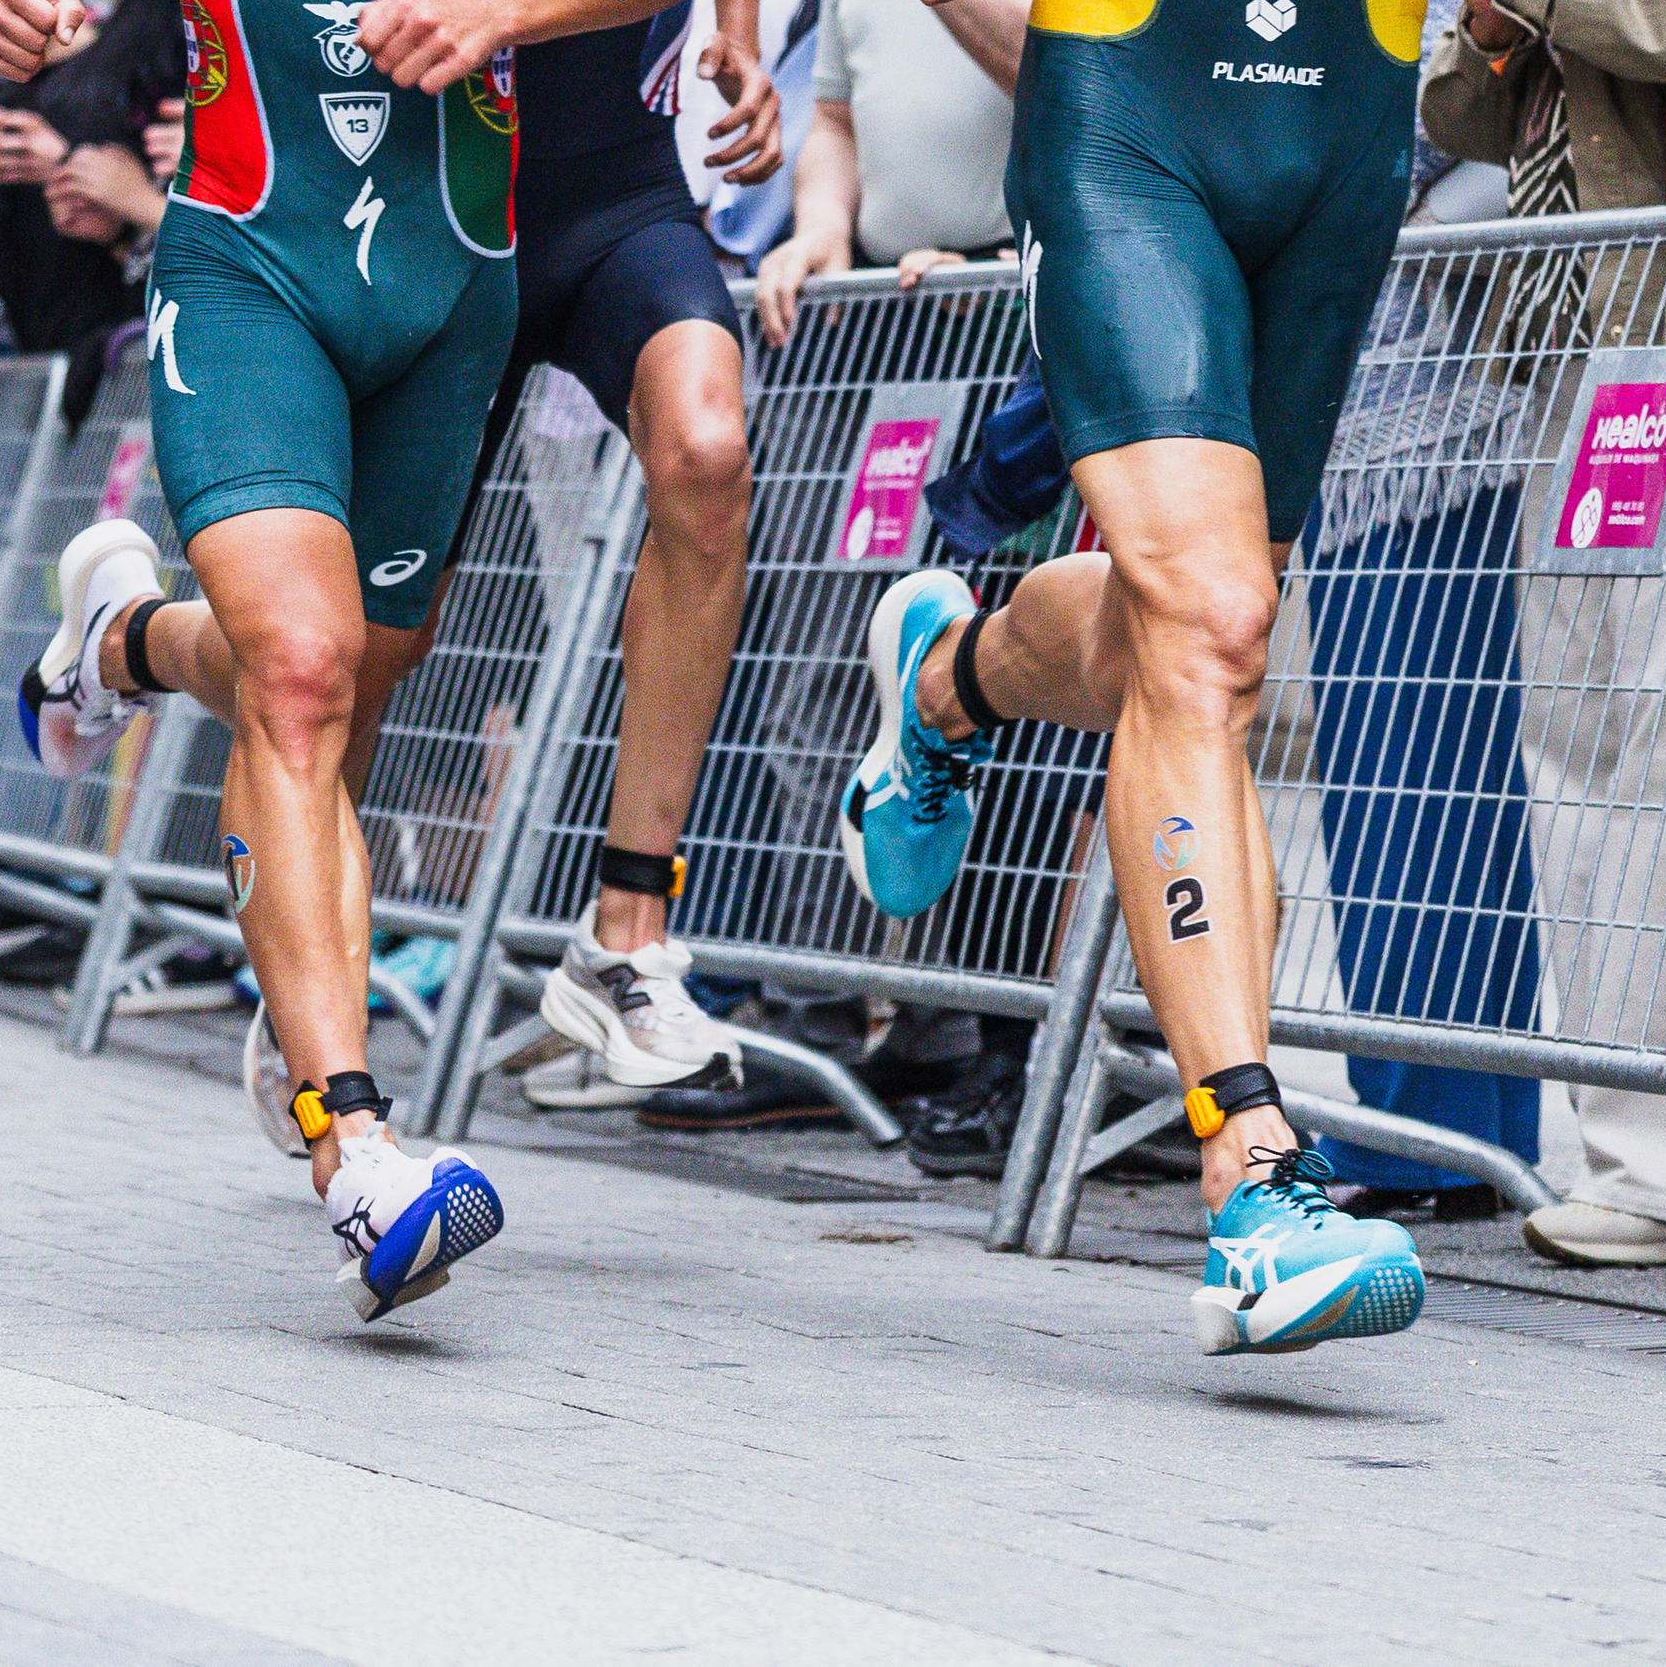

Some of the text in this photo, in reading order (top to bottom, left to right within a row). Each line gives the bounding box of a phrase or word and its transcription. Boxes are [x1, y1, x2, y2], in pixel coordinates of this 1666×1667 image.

[1212, 61, 1325, 86] PLASMAIDE
[346, 118, 369, 133] 13
[1166, 877, 1210, 941] 2
